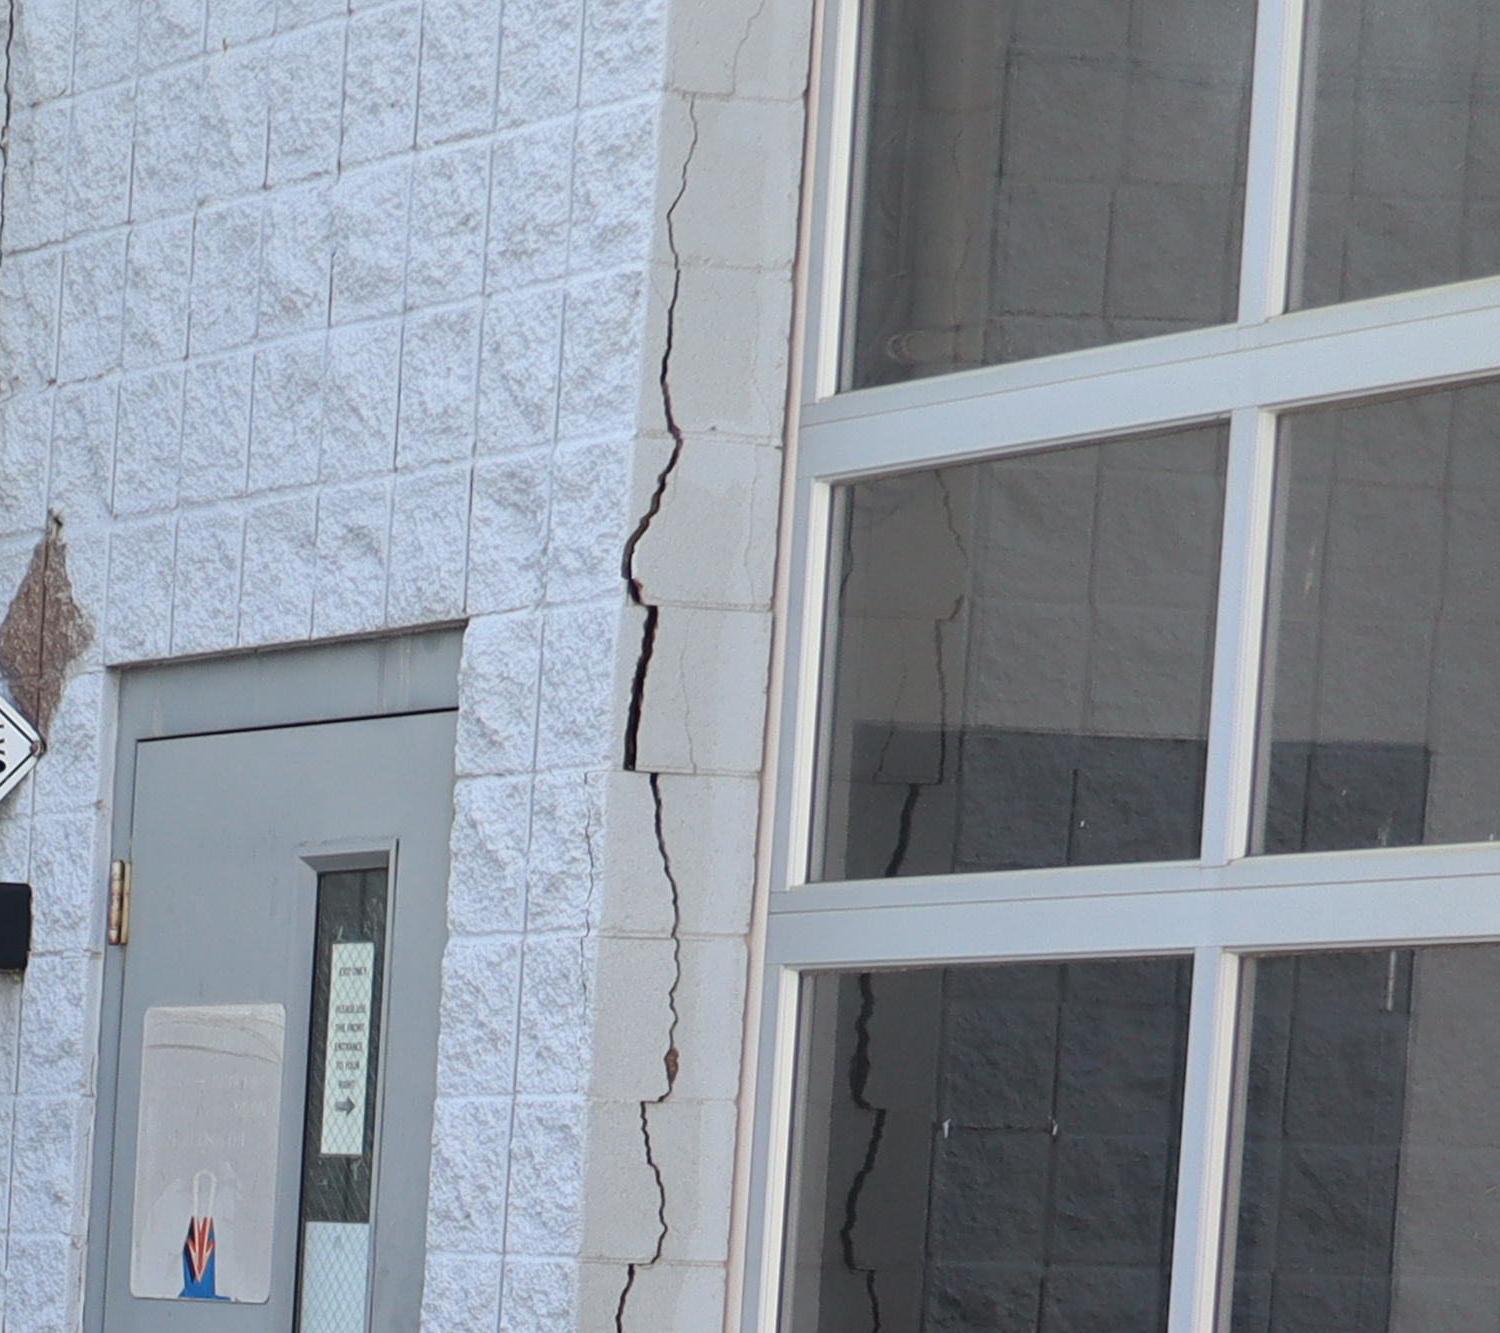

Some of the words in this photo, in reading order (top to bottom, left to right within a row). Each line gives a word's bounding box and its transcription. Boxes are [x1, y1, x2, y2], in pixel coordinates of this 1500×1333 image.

[338, 967, 351, 977] EXIT
[352, 966, 367, 976] ONLY
[335, 1004, 355, 1014] PLEASE
[335, 1023, 345, 1032] THE
[346, 1023, 365, 1032] FRONT
[334, 1042, 363, 1051] ENTRANCE
[336, 1061, 344, 1070] TO
[345, 1061, 360, 1070] YOUR
[338, 1079, 356, 1089] RIGHT
